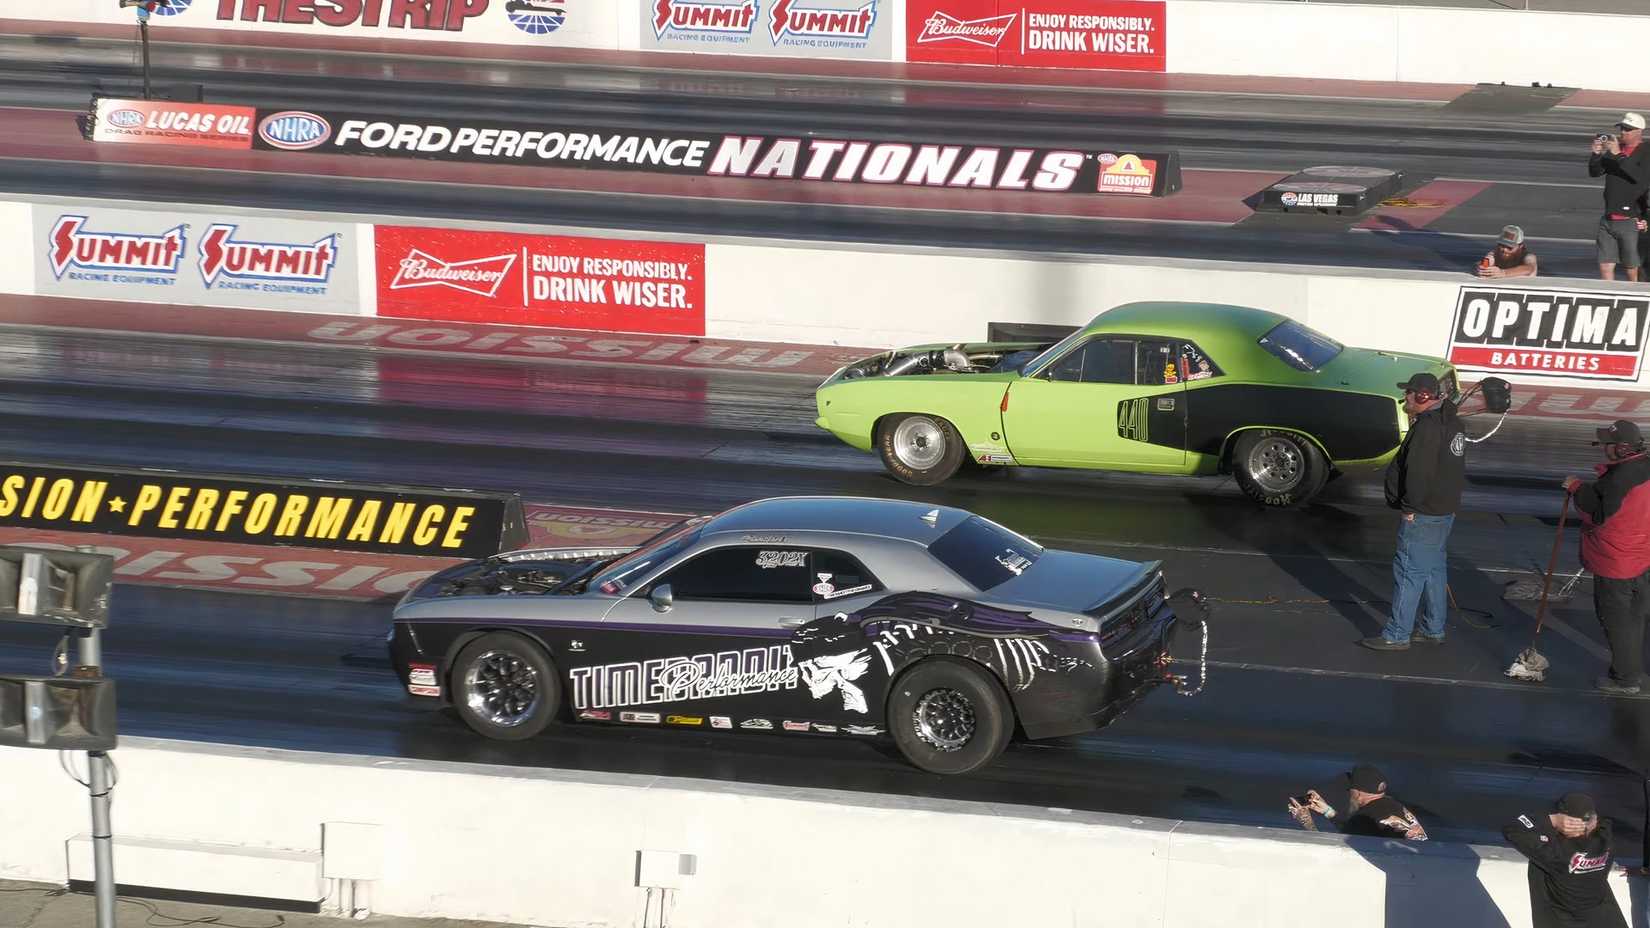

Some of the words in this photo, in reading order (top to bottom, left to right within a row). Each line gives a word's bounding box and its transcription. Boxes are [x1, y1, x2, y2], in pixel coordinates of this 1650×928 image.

[925, 18, 1005, 36] Budweiser
[1029, 13, 1067, 28] ENJOY
[1069, 15, 1155, 31] RESPONSIBLY.
[1029, 31, 1087, 51] DRINK
[1092, 33, 1155, 53] WISER.
[104, 128, 142, 136] DRAG
[146, 110, 212, 132] LUCAS
[217, 117, 251, 136] OIL
[268, 117, 321, 142] NHRA
[335, 120, 451, 152] FORD
[450, 128, 710, 167] PERFORMANCE
[707, 135, 1085, 192] NATIONALS
[1298, 193, 1312, 202] LAS
[1314, 193, 1338, 203] VEGAS
[69, 272, 110, 282] RACING
[112, 274, 175, 285] EQUIPMENT
[399, 257, 504, 282] Budweiser
[532, 254, 579, 274] ENJOY
[583, 257, 693, 281] RESPONSIBLY.
[219, 281, 259, 292] RACING
[262, 284, 327, 294] EQUIPMENT
[532, 275, 608, 304] DRINK
[612, 279, 693, 309] WISER.
[1462, 299, 1638, 346] OPTIMA
[1491, 352, 1600, 371] BATTERIES
[1119, 398, 1149, 441] 440
[128, 484, 476, 548] PERFORMANCE
